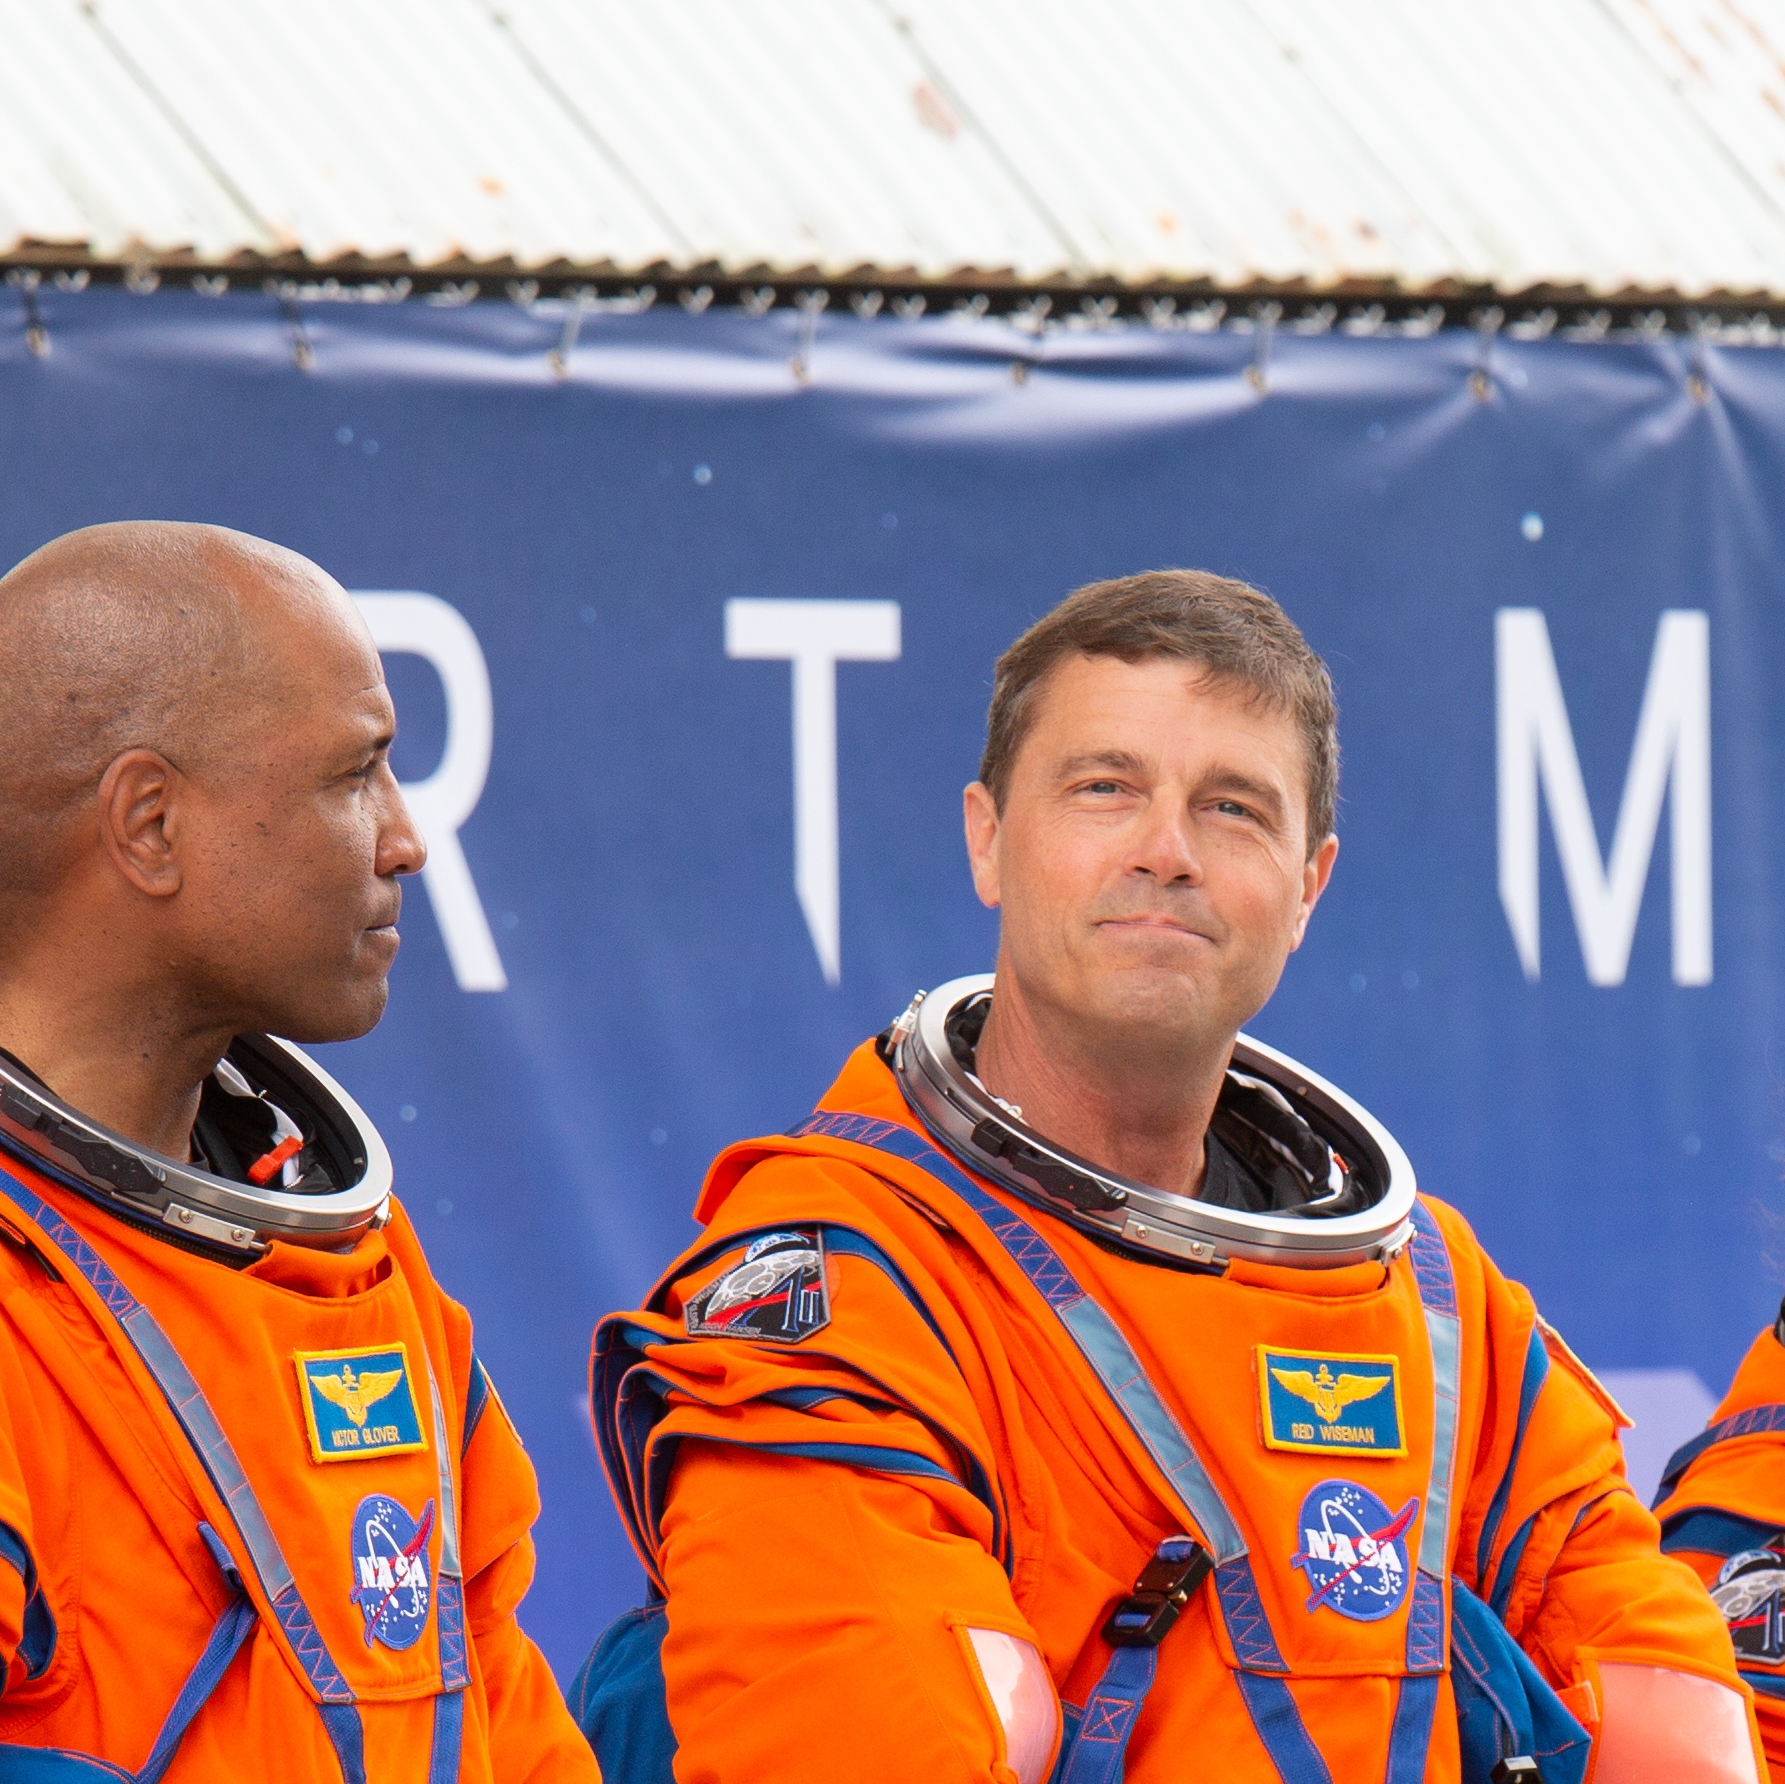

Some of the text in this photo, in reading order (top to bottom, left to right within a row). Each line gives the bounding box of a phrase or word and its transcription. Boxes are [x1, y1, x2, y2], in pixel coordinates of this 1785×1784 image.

[362, 1425, 400, 1444] GLOVER
[1291, 1422, 1375, 1444] REID WISEMAN
[1305, 1529, 1403, 1573] NASA
[358, 1556, 428, 1588] NASA
